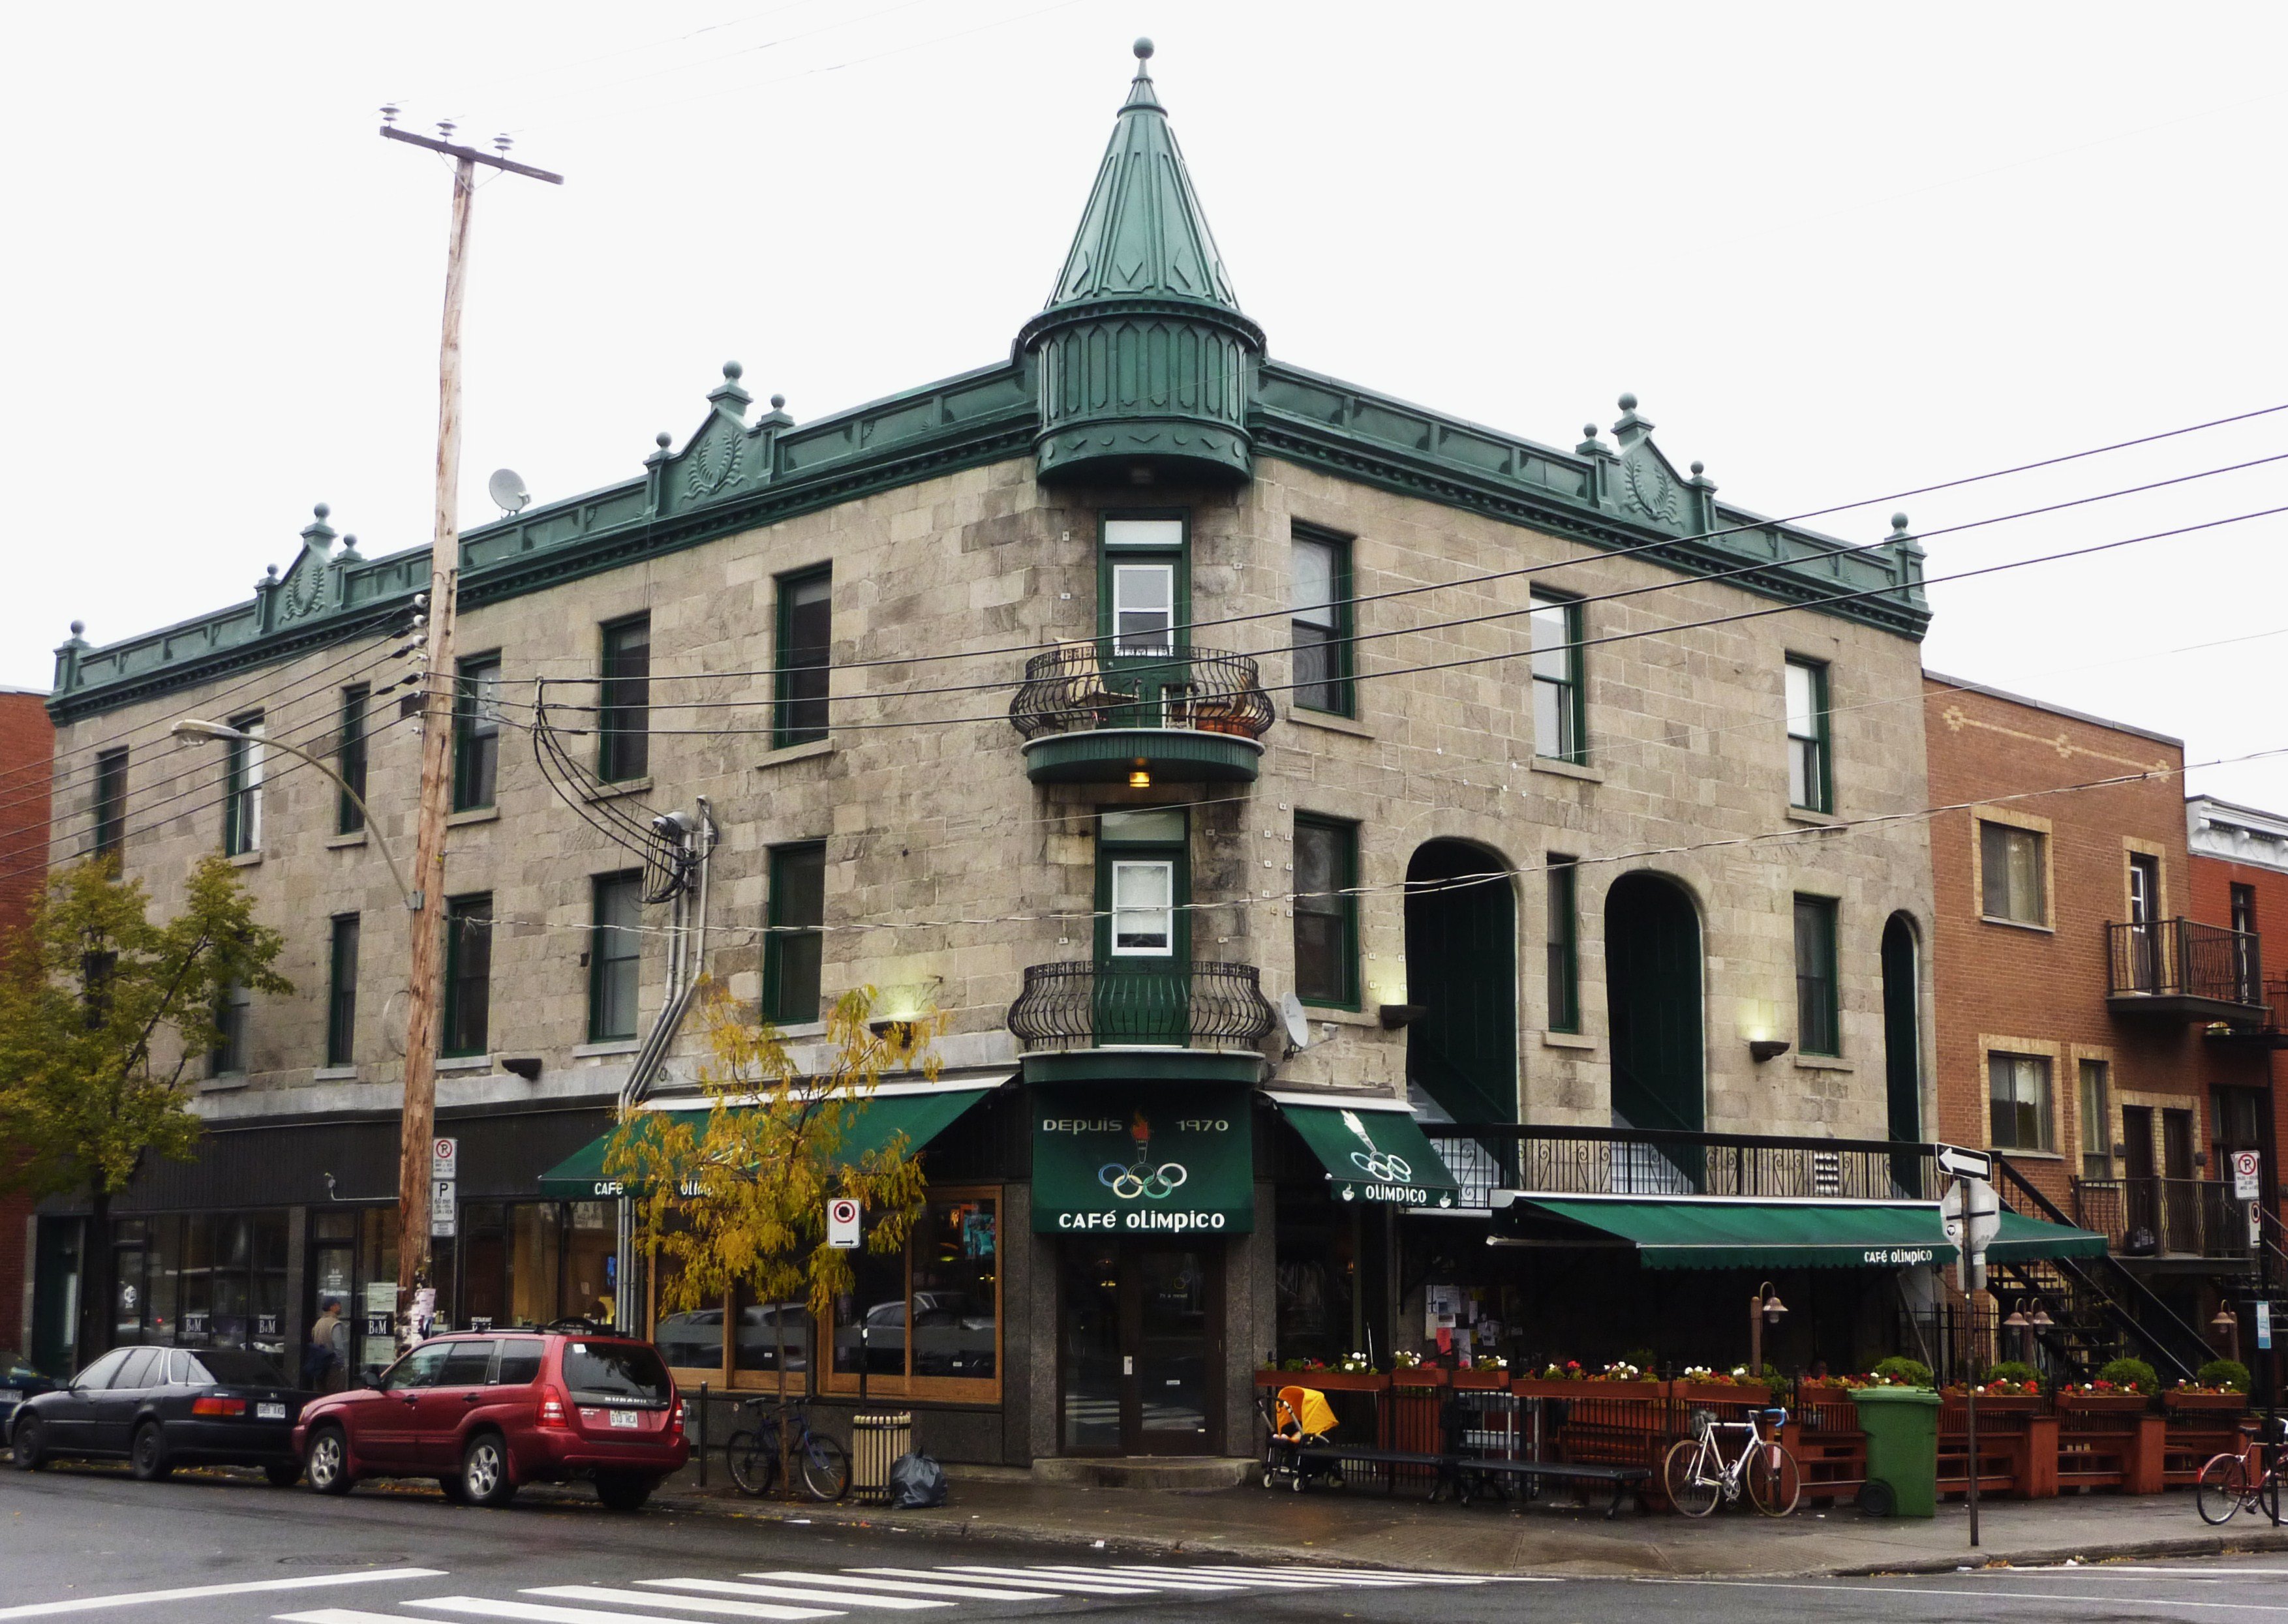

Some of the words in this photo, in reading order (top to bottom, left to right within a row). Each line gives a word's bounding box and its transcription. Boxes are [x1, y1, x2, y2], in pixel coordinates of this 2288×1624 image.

[1176, 1120, 1228, 1132] 1970
[439, 1182, 448, 1197] P
[1059, 1210, 1116, 1229] CAFé
[1864, 1250, 1887, 1263] CAFé
